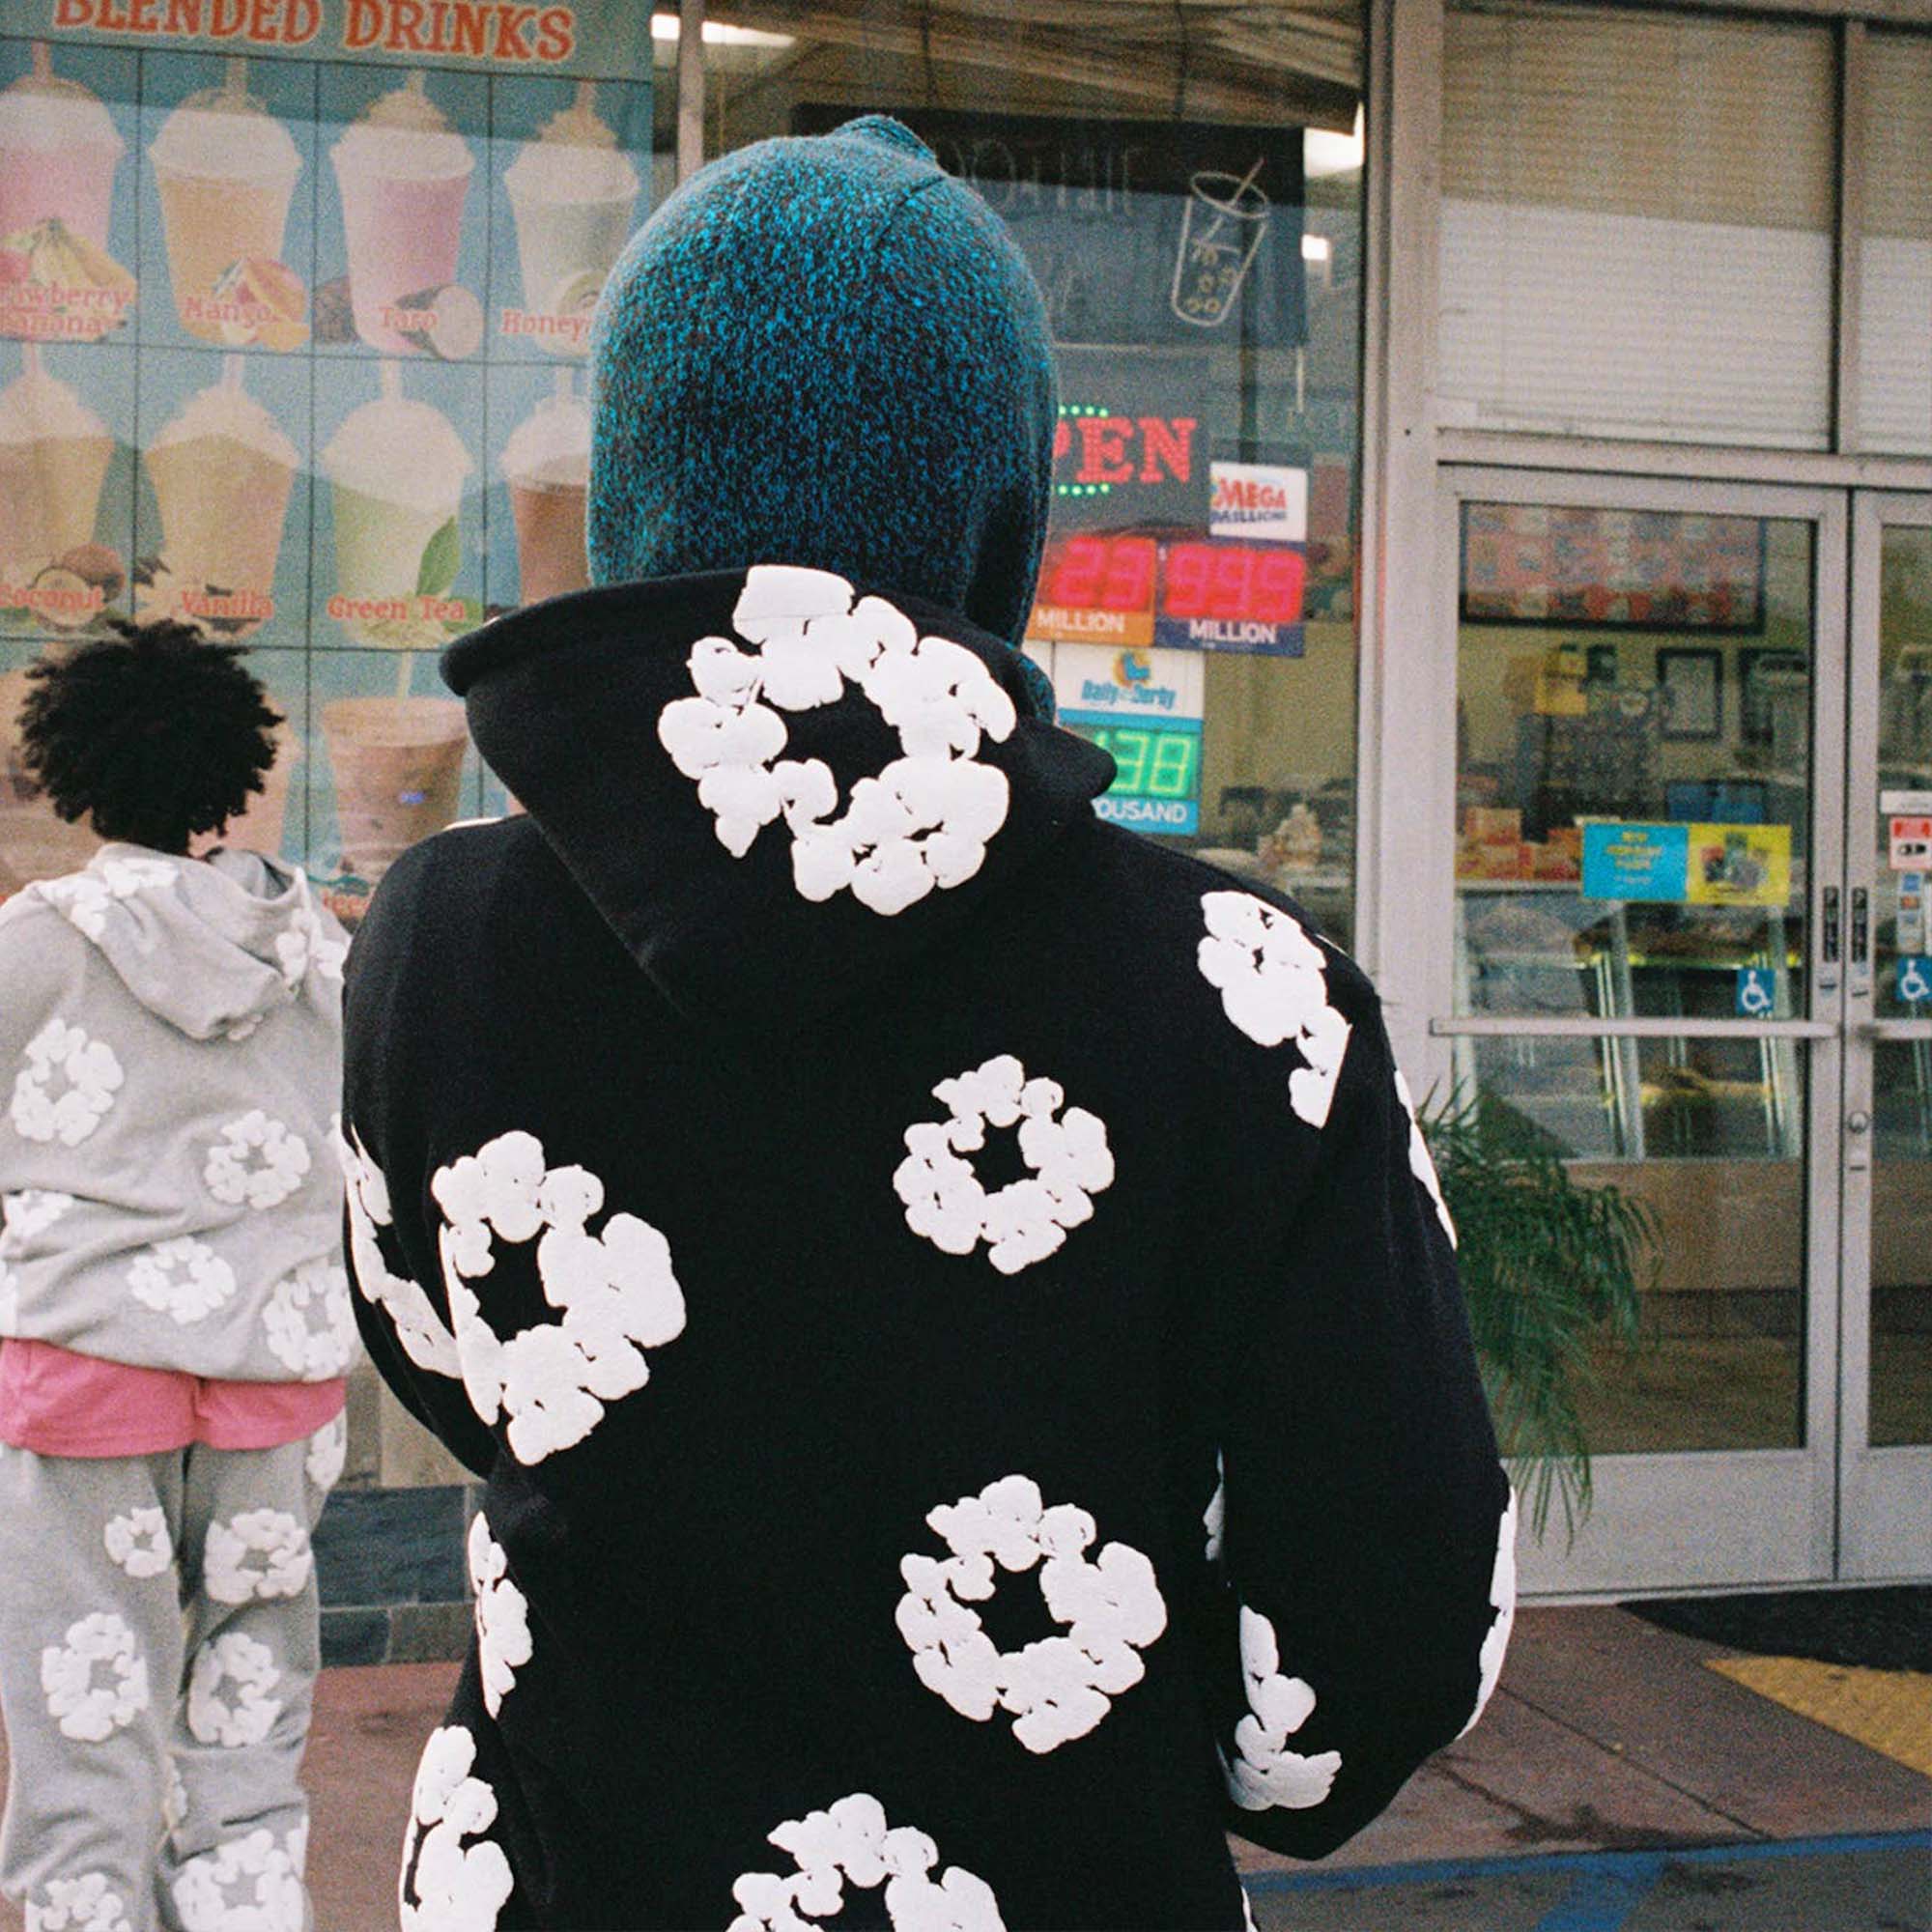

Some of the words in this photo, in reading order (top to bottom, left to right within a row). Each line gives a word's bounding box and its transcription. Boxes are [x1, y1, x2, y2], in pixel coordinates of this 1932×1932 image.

[55, 0, 321, 43] BLENDED
[344, 0, 574, 61] DRINKS
[379, 306, 438, 330] Taro
[501, 308, 592, 342] Honey
[1211, 477, 1287, 510] MEGA
[182, 588, 274, 618] Vanilla
[327, 593, 408, 620] Green
[418, 594, 466, 621] Tea
[1037, 609, 1125, 634] MILLION
[1189, 618, 1277, 644] MILLION
[1094, 729, 1191, 796] 38
[1093, 799, 1188, 824] OUSAND
